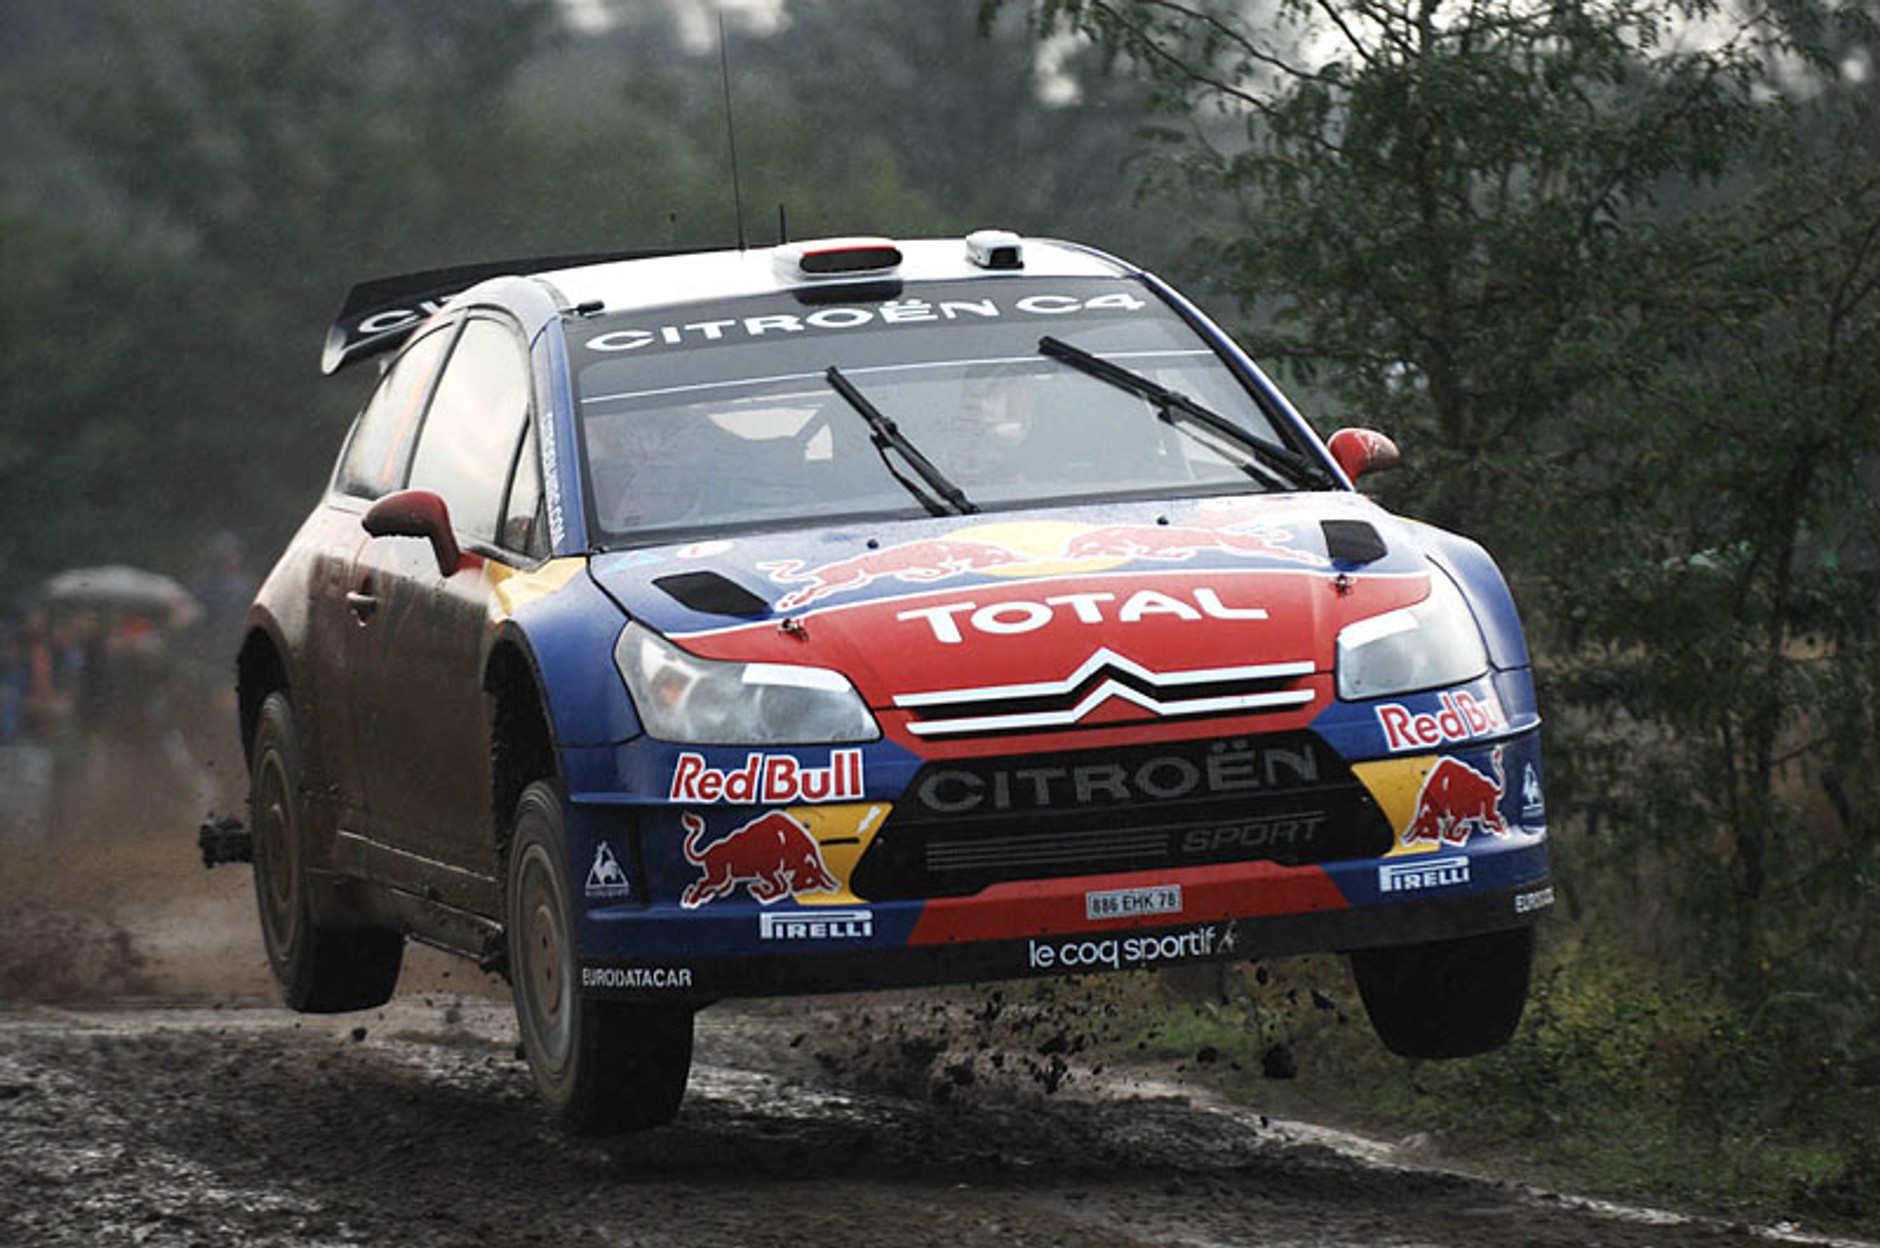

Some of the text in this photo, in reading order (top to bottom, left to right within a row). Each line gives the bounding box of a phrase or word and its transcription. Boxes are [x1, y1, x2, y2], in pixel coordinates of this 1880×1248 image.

[585, 292, 1147, 352] CITROËN C4
[897, 587, 1269, 644] TOTAL
[1374, 692, 1470, 752] Red
[670, 748, 864, 803] Red Bull
[918, 739, 1319, 812] CITROËN
[1181, 815, 1326, 853] SPORT
[1379, 855, 1470, 892] PIRELLI
[1122, 893, 1153, 911] EHK
[759, 910, 873, 939] PIRELLI
[1029, 926, 1216, 970] le coq sportif
[582, 967, 692, 987] EURODATACAR
